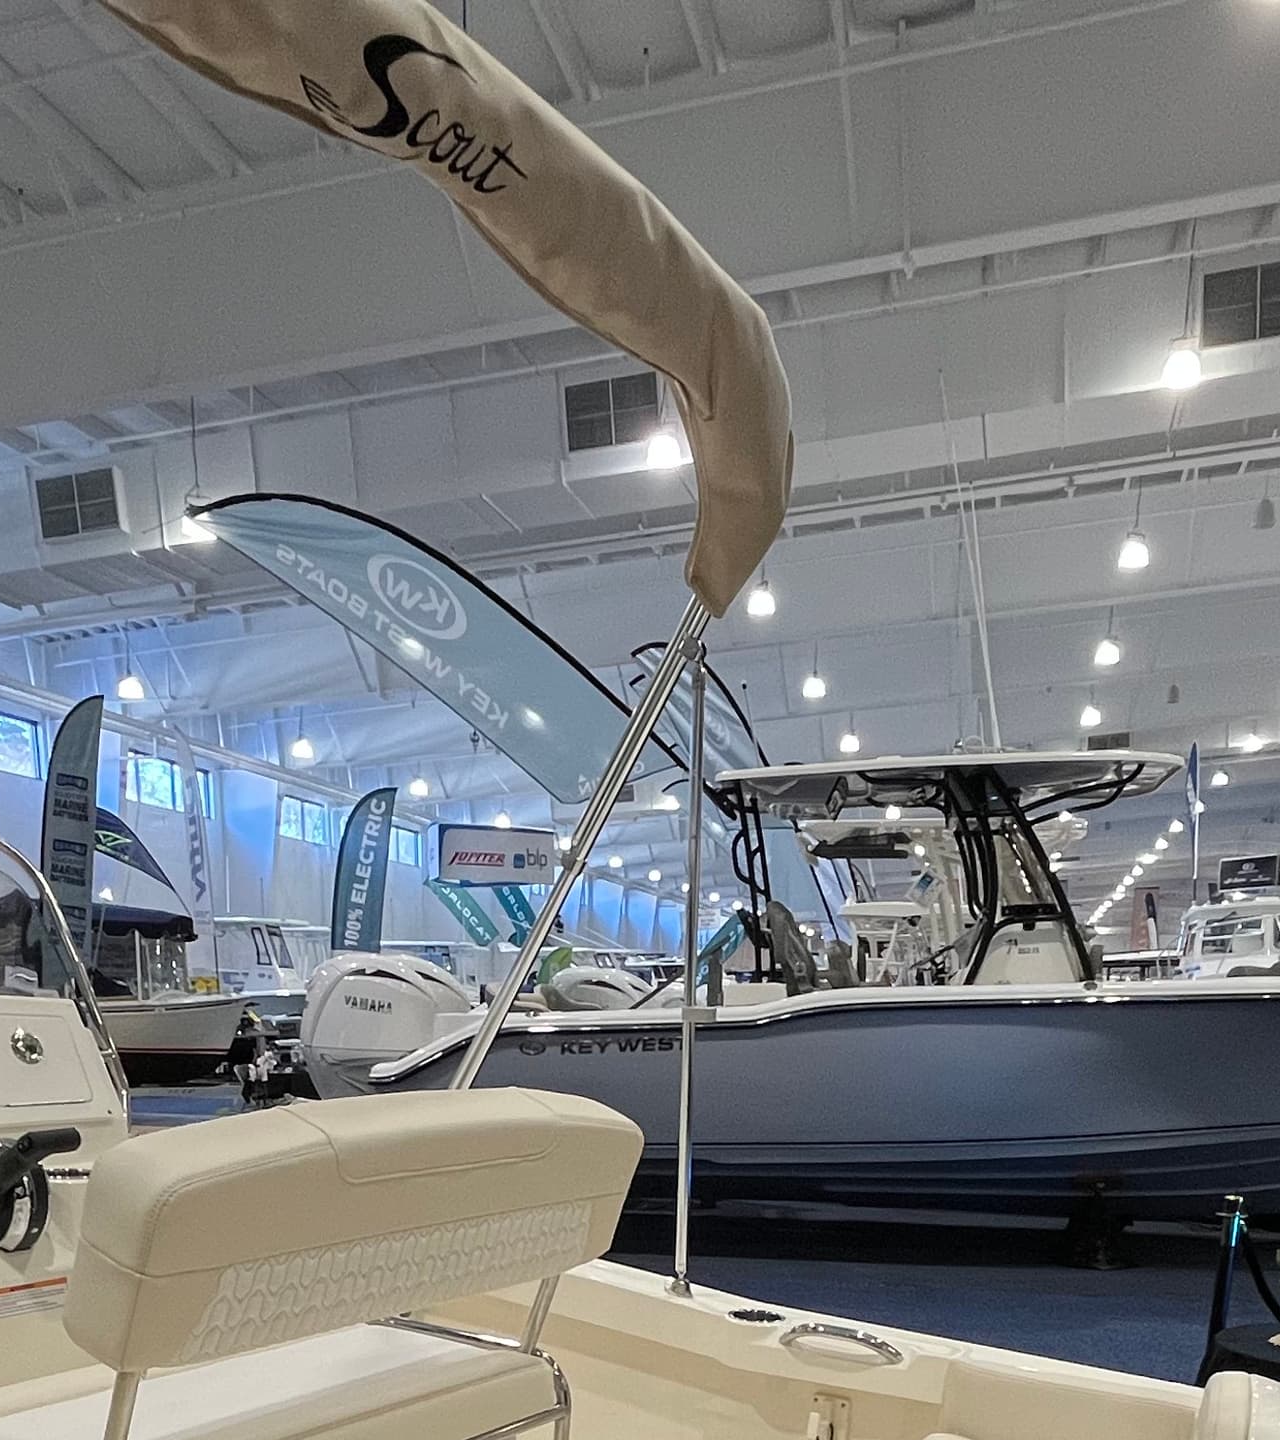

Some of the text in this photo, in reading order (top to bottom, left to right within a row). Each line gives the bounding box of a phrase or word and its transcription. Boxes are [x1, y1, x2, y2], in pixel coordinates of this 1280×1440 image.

[300, 34, 528, 194] Scout
[343, 798, 387, 948] 100% ELECTRIC
[448, 848, 549, 872] JUPITER blp
[439, 886, 493, 943] ORLDCAT
[344, 995, 393, 1015] YAMAHA
[560, 1038, 685, 1056] KEY WEST
